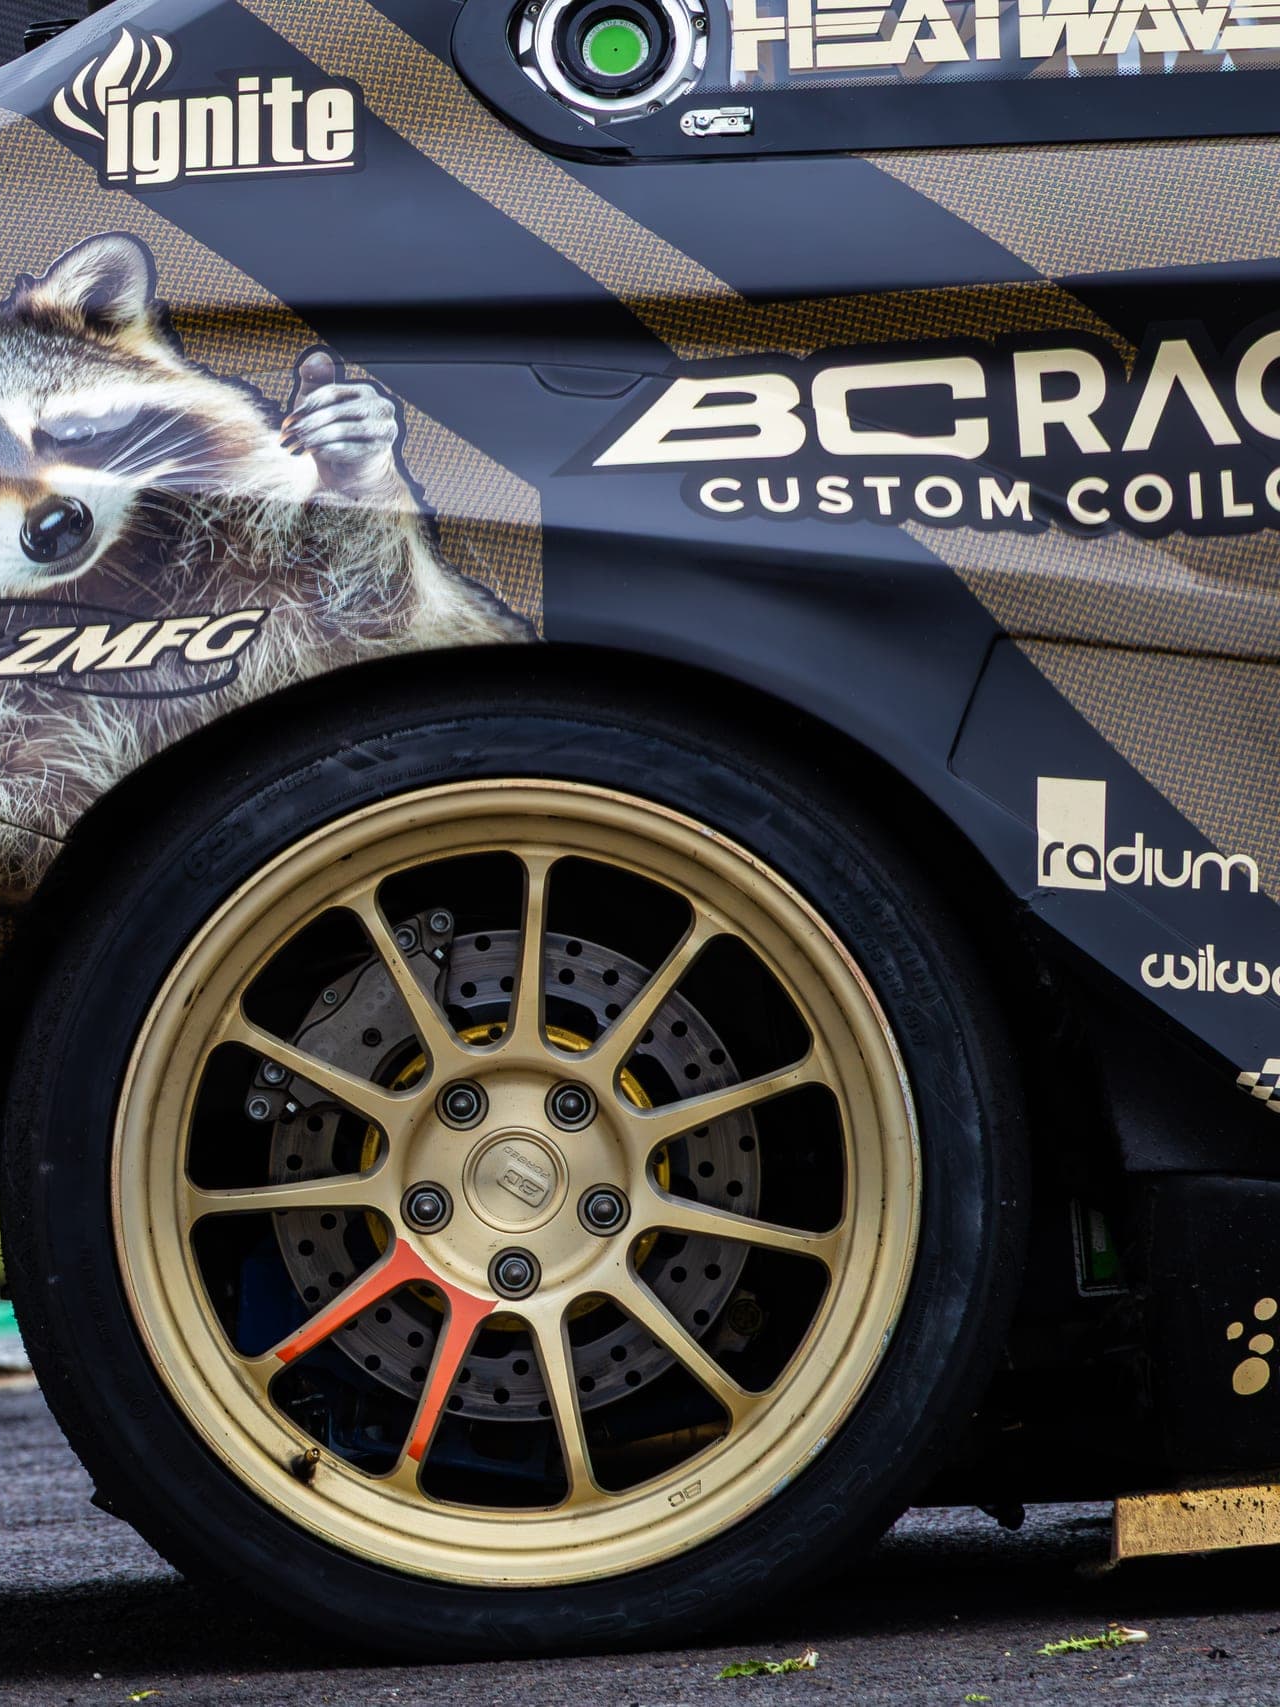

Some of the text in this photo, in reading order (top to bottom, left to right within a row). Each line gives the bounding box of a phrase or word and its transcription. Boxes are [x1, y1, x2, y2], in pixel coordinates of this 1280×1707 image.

[107, 76, 355, 185] ignite
[700, 476, 1032, 522] CUSTOM
[1042, 833, 1259, 892] radium
